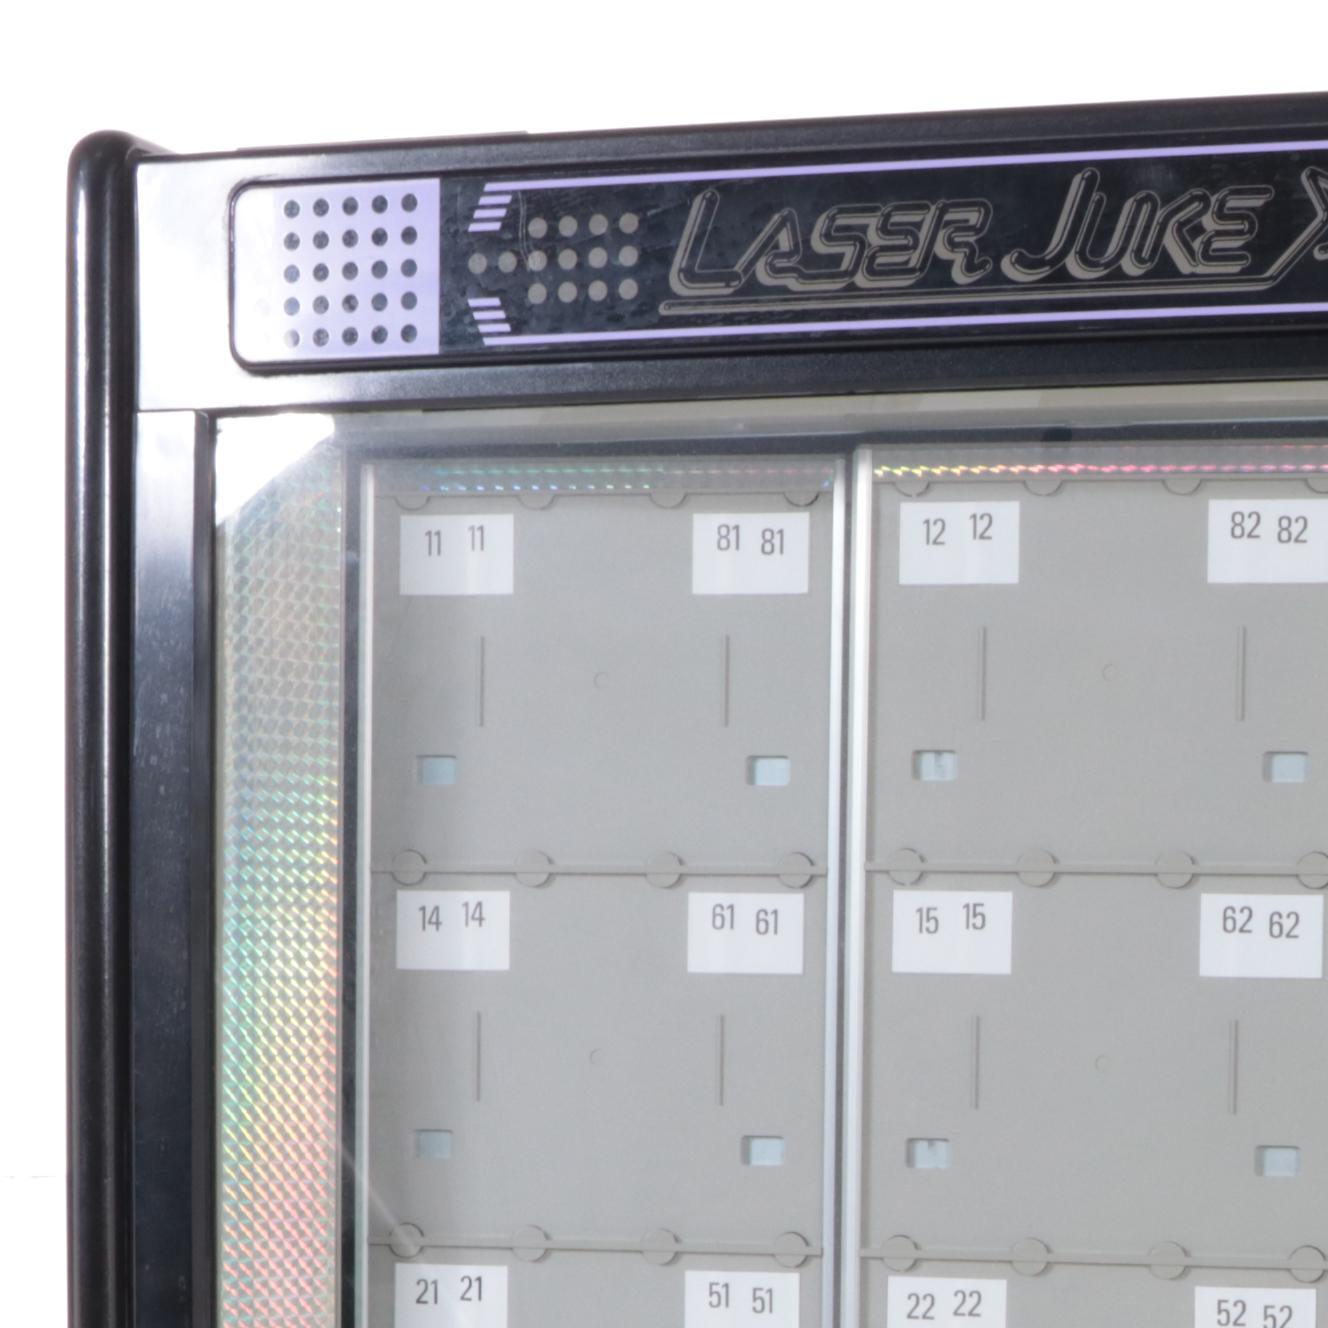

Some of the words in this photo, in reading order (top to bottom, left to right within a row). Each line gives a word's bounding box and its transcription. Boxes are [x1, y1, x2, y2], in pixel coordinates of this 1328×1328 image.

[669, 189, 992, 294] LASER
[1002, 167, 1274, 281] JUKE
[425, 530, 441, 556] 11
[469, 525, 484, 551] 11
[717, 524, 740, 551] 81
[761, 528, 784, 555] 81
[923, 518, 946, 545] 12
[970, 513, 993, 540] 12
[1231, 511, 1261, 539] 82
[1277, 515, 1308, 544] 82
[419, 905, 442, 931] 14
[462, 901, 485, 927] 14
[712, 904, 734, 930] 61
[756, 909, 778, 935] 61
[916, 907, 939, 934] 15
[963, 903, 986, 930] 15
[1223, 906, 1253, 933] 62
[1269, 911, 1300, 939] 62
[416, 1278, 438, 1304] 21
[460, 1275, 482, 1302] 21
[709, 1282, 729, 1308] 51
[752, 1287, 773, 1313] 51
[907, 1293, 935, 1320] 22
[953, 1290, 982, 1317] 22
[1217, 1299, 1246, 1327] 52
